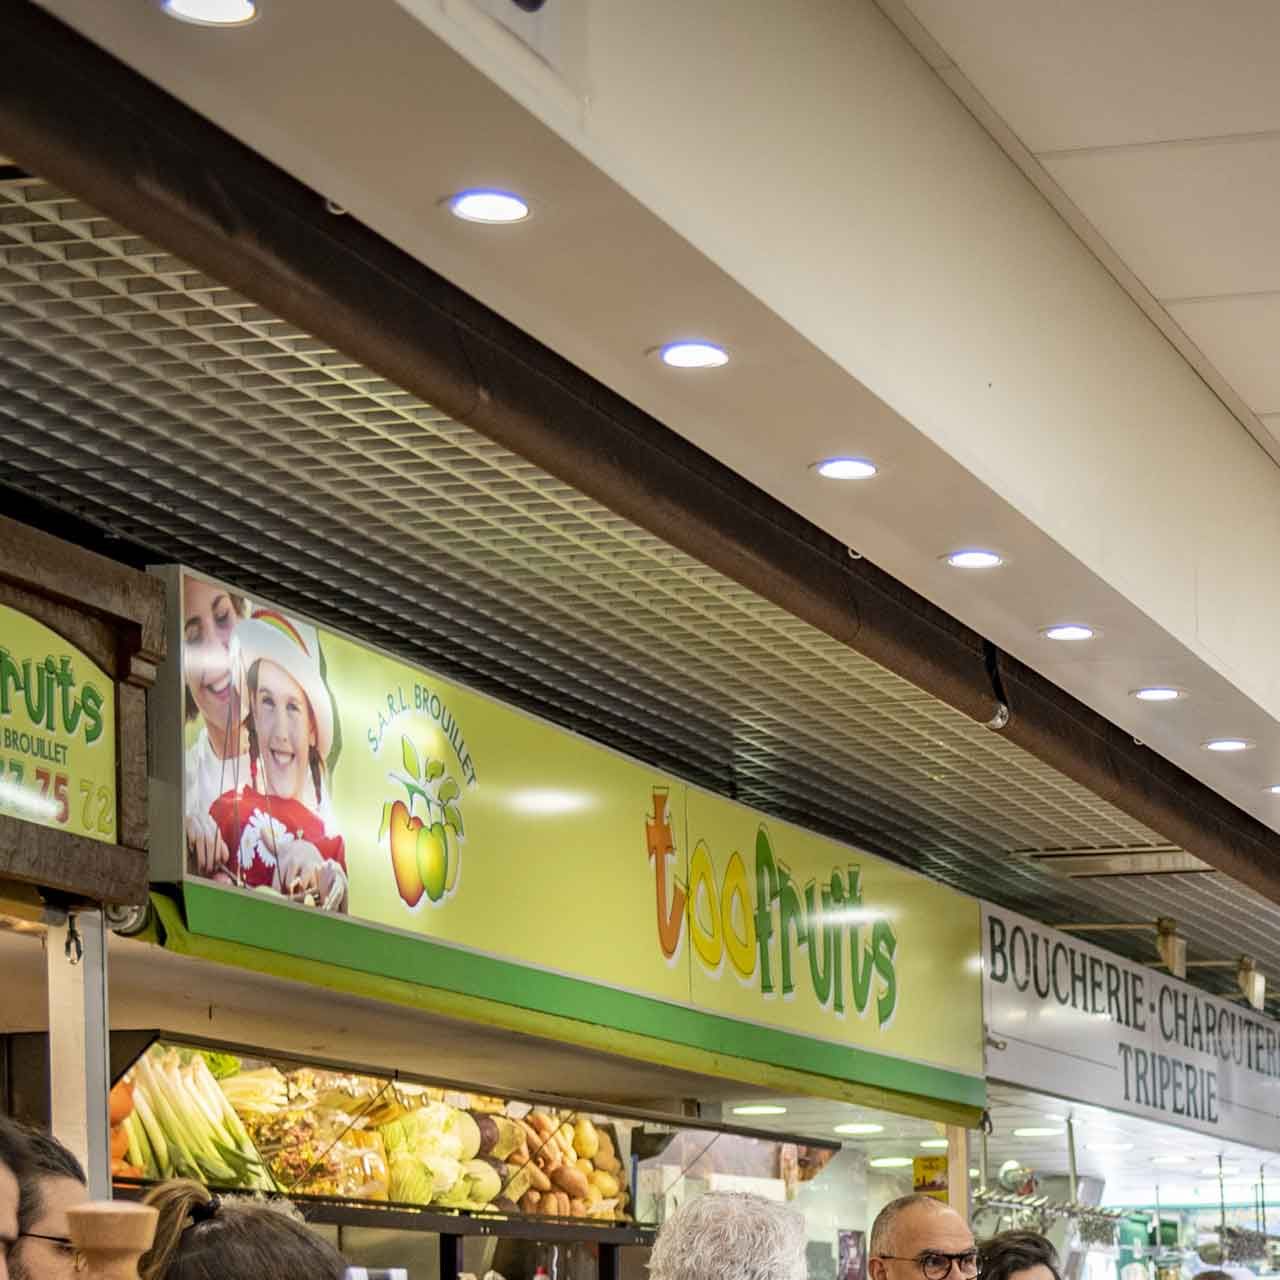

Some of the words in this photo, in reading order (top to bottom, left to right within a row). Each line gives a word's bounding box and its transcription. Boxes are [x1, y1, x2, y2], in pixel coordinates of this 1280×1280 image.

[3, 728, 68, 766] BROUILLET
[415, 684, 477, 785] BROUILLET
[79, 777, 113, 834] 72
[988, 914, 1146, 1032] BOUCHERIE
[1118, 1042, 1219, 1124] TRIPERIE
